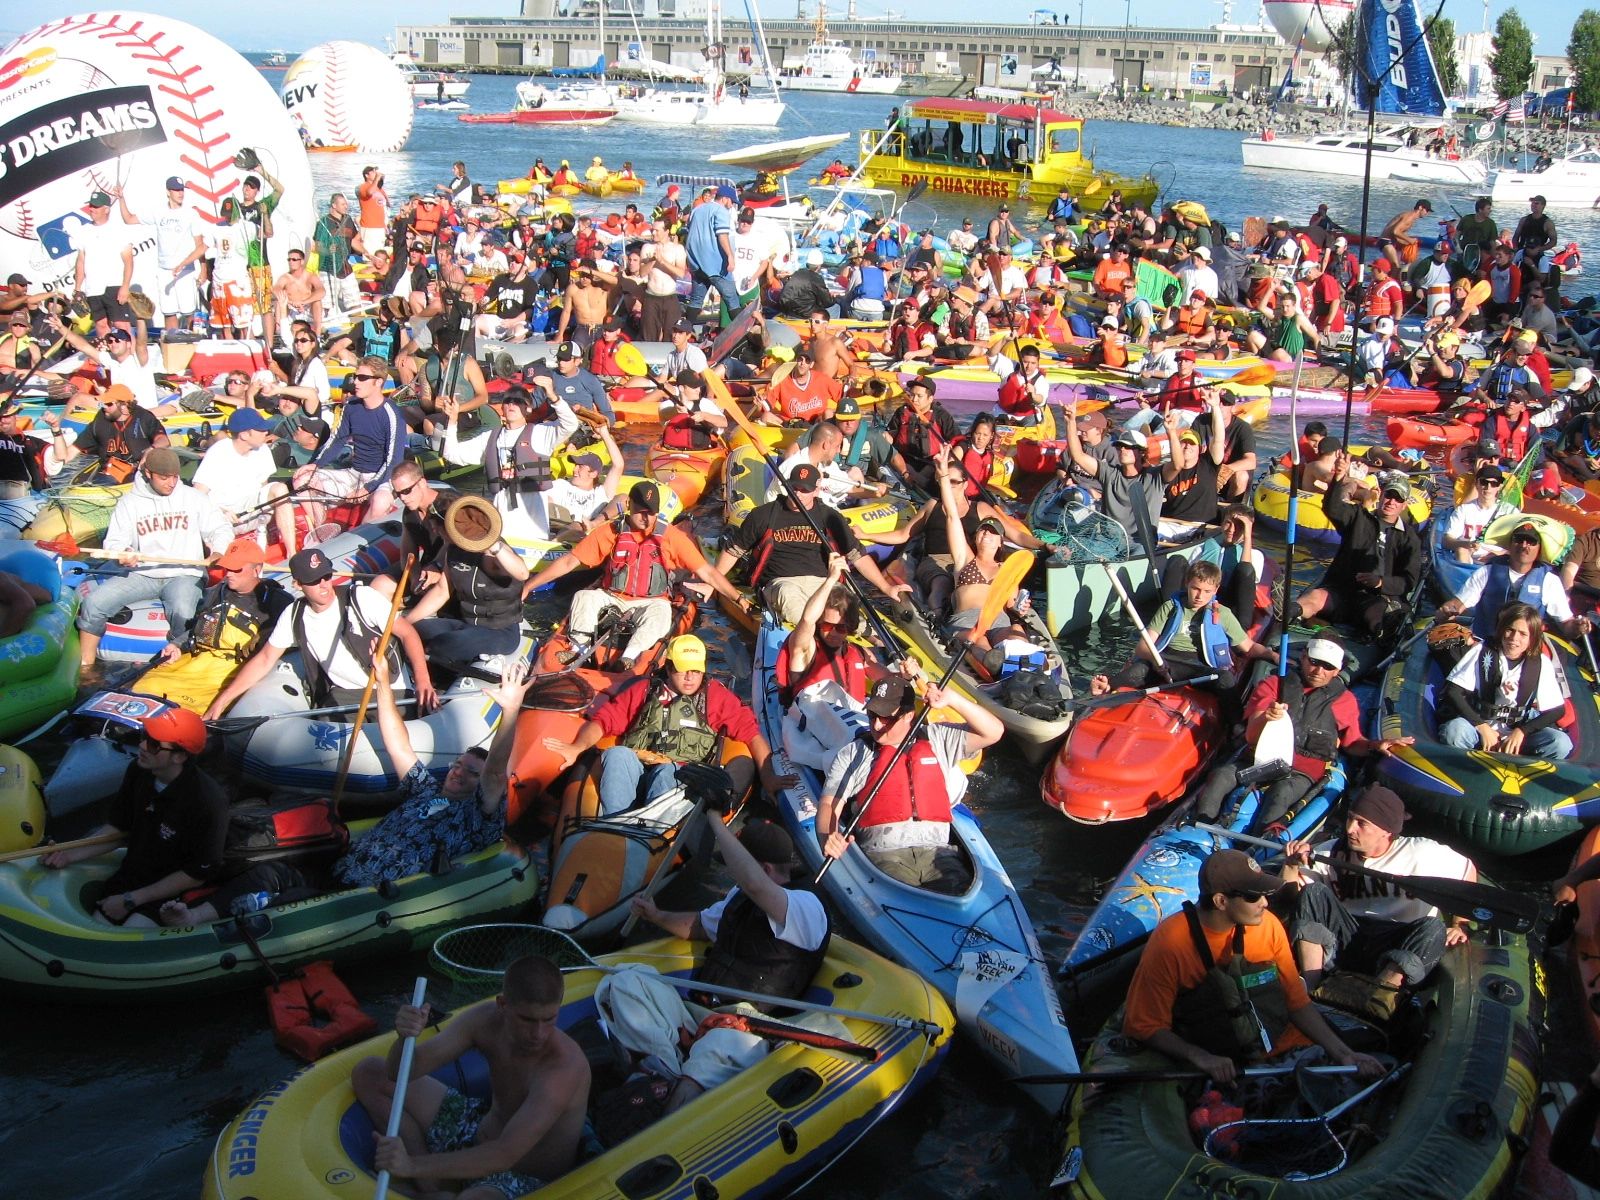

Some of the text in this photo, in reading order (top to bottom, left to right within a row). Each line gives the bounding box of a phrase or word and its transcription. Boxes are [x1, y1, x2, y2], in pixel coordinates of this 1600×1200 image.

[1385, 14, 1408, 90] BUD
[8, 101, 157, 168] DREAMS
[933, 176, 1009, 198] QUACKERS
[737, 247, 755, 261] 56
[136, 515, 189, 537] GIANTS
[159, 926, 195, 937] 240
